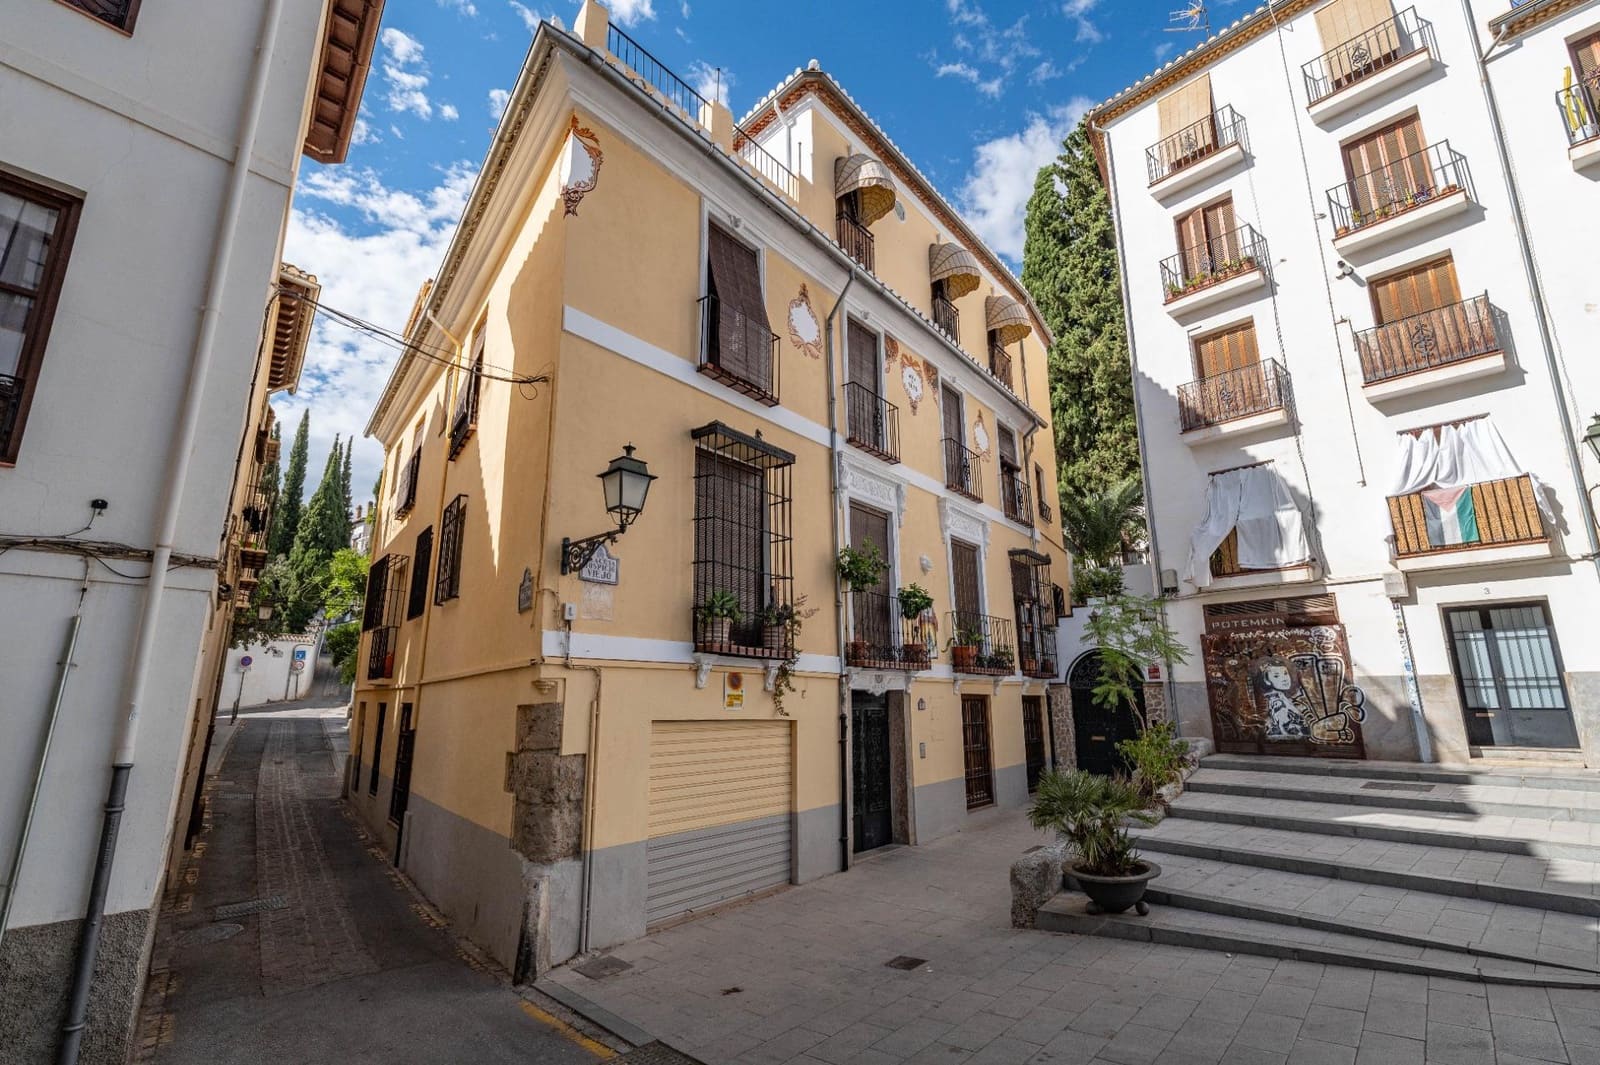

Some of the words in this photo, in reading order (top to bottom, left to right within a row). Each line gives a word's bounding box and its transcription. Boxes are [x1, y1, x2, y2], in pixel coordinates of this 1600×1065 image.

[587, 568, 612, 580] VIEJO
[1483, 587, 1491, 595] 3
[1212, 617, 1285, 630] POTEMKIN
